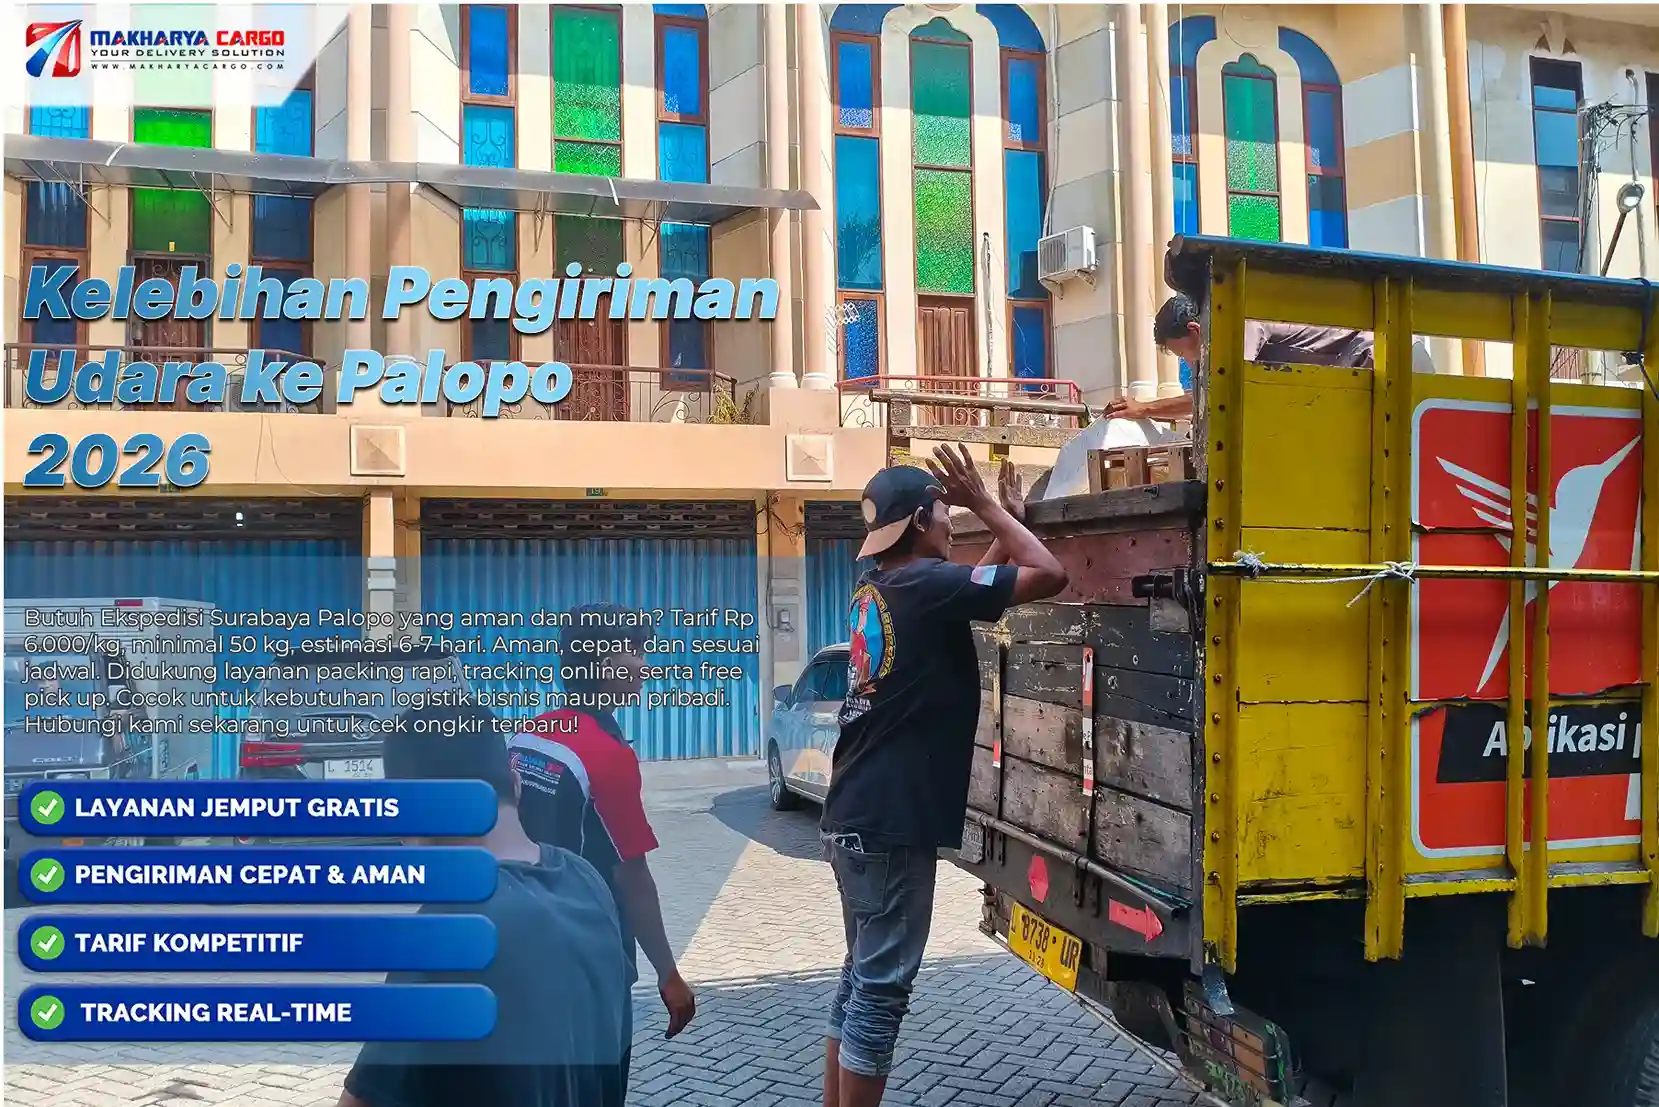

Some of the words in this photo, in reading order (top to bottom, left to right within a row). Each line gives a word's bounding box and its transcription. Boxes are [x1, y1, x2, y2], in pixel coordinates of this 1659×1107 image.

[1483, 711, 1628, 757] Aikasi
[327, 760, 335, 772] L
[344, 759, 373, 773] 1514
[1022, 914, 1050, 953] 8738
[1060, 936, 1079, 972] UR
